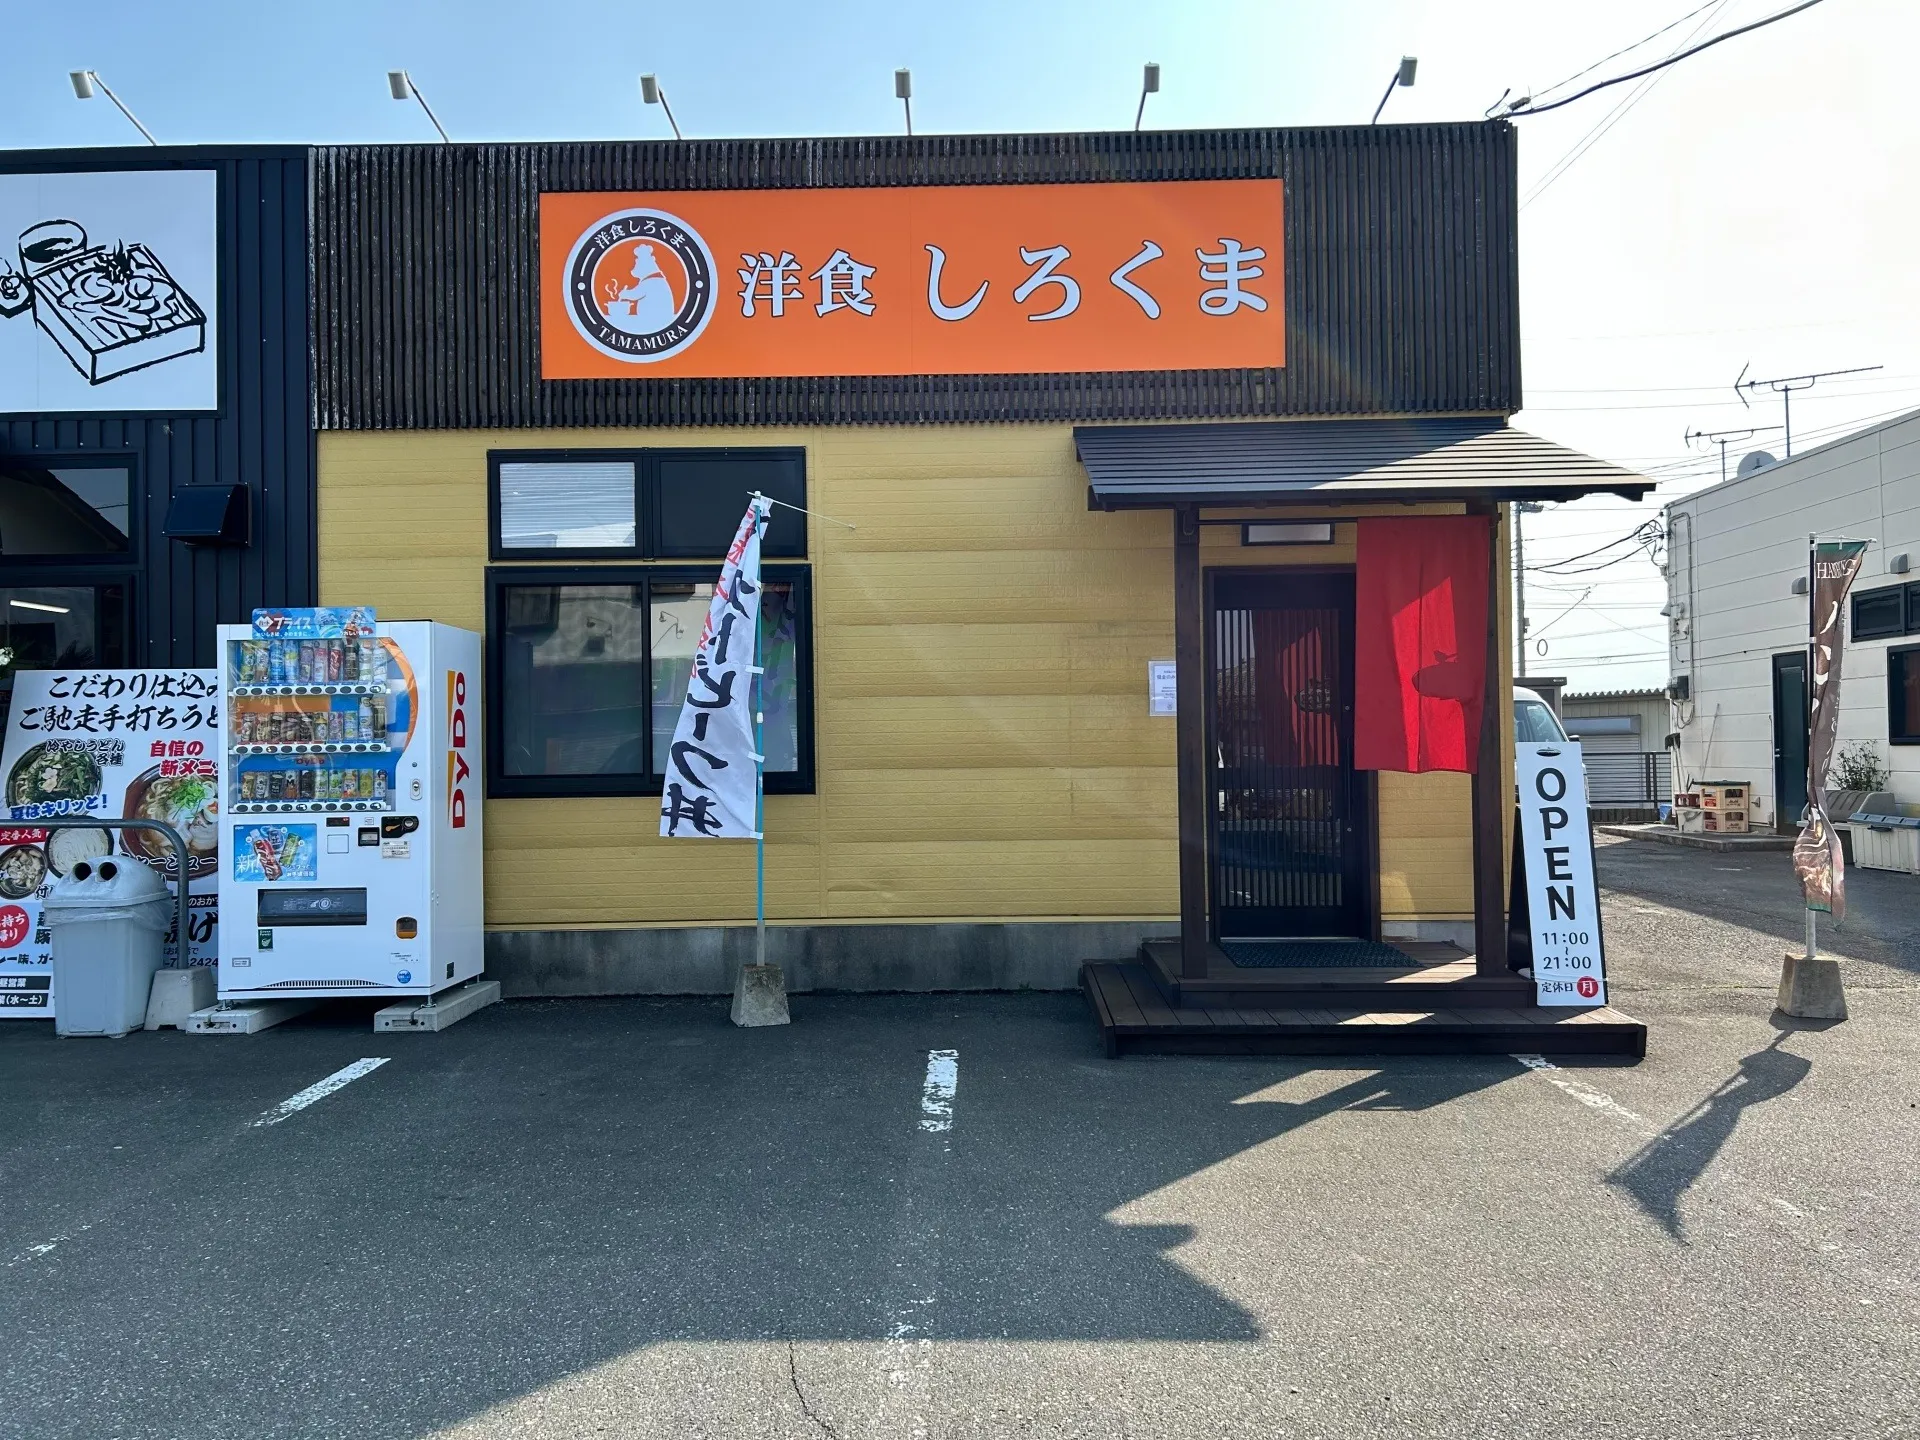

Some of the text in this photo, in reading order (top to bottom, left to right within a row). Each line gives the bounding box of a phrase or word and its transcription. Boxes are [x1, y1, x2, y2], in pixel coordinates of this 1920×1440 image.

[594, 219, 686, 249] 洋食しろくま
[737, 238, 1269, 322] 洋食 しろくま
[598, 325, 688, 350] TAMAMURA
[150, 740, 204, 757] 自信の
[1536, 767, 1576, 921] OPEN
[0, 913, 25, 928] 持ち
[1542, 932, 1589, 945] 11:00
[1543, 956, 1592, 970] 21:00
[1541, 982, 1573, 993] 定休日
